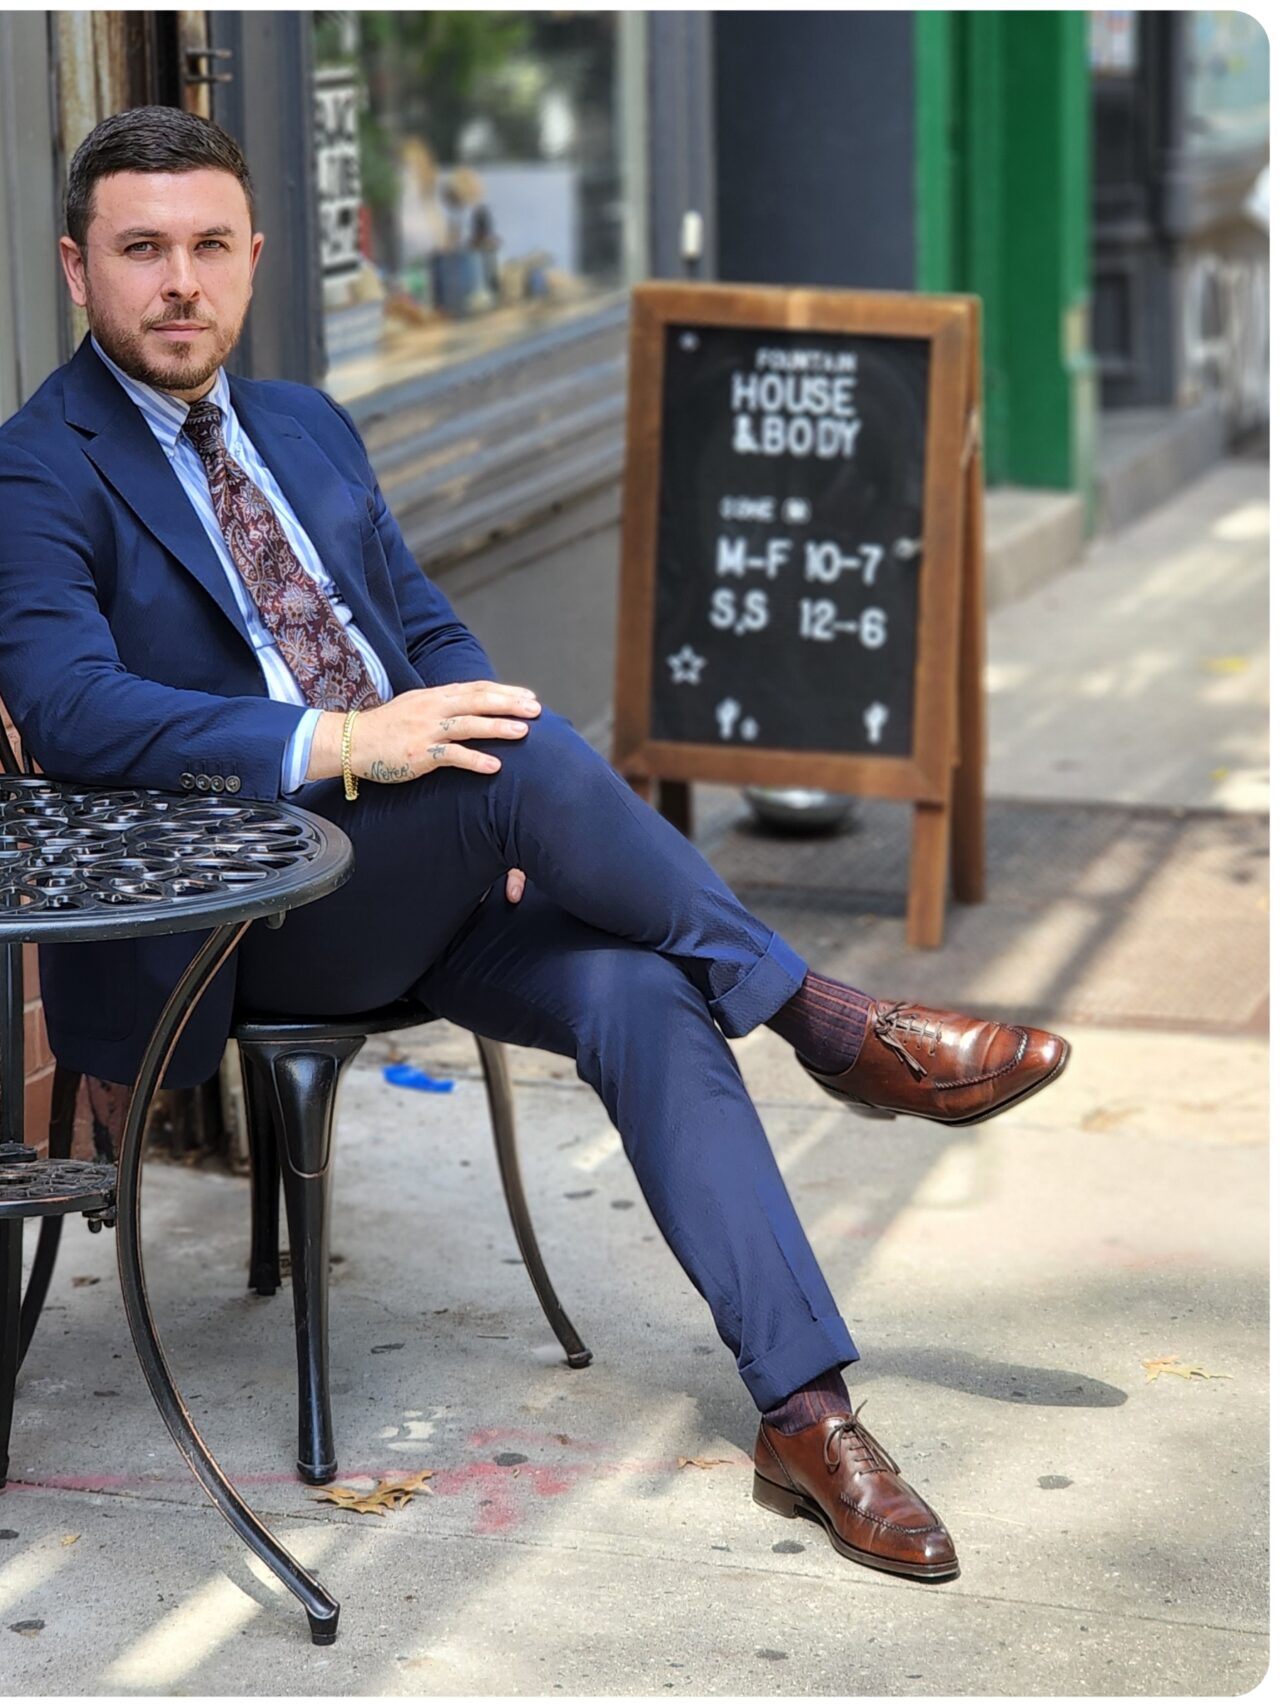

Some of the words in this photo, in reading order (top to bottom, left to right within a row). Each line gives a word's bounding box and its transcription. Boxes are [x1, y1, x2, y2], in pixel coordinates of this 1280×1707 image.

[732, 373, 857, 416] HOUSE
[717, 537, 792, 579] M-F
[804, 541, 884, 585] 10-7
[799, 598, 888, 649] 12-6
